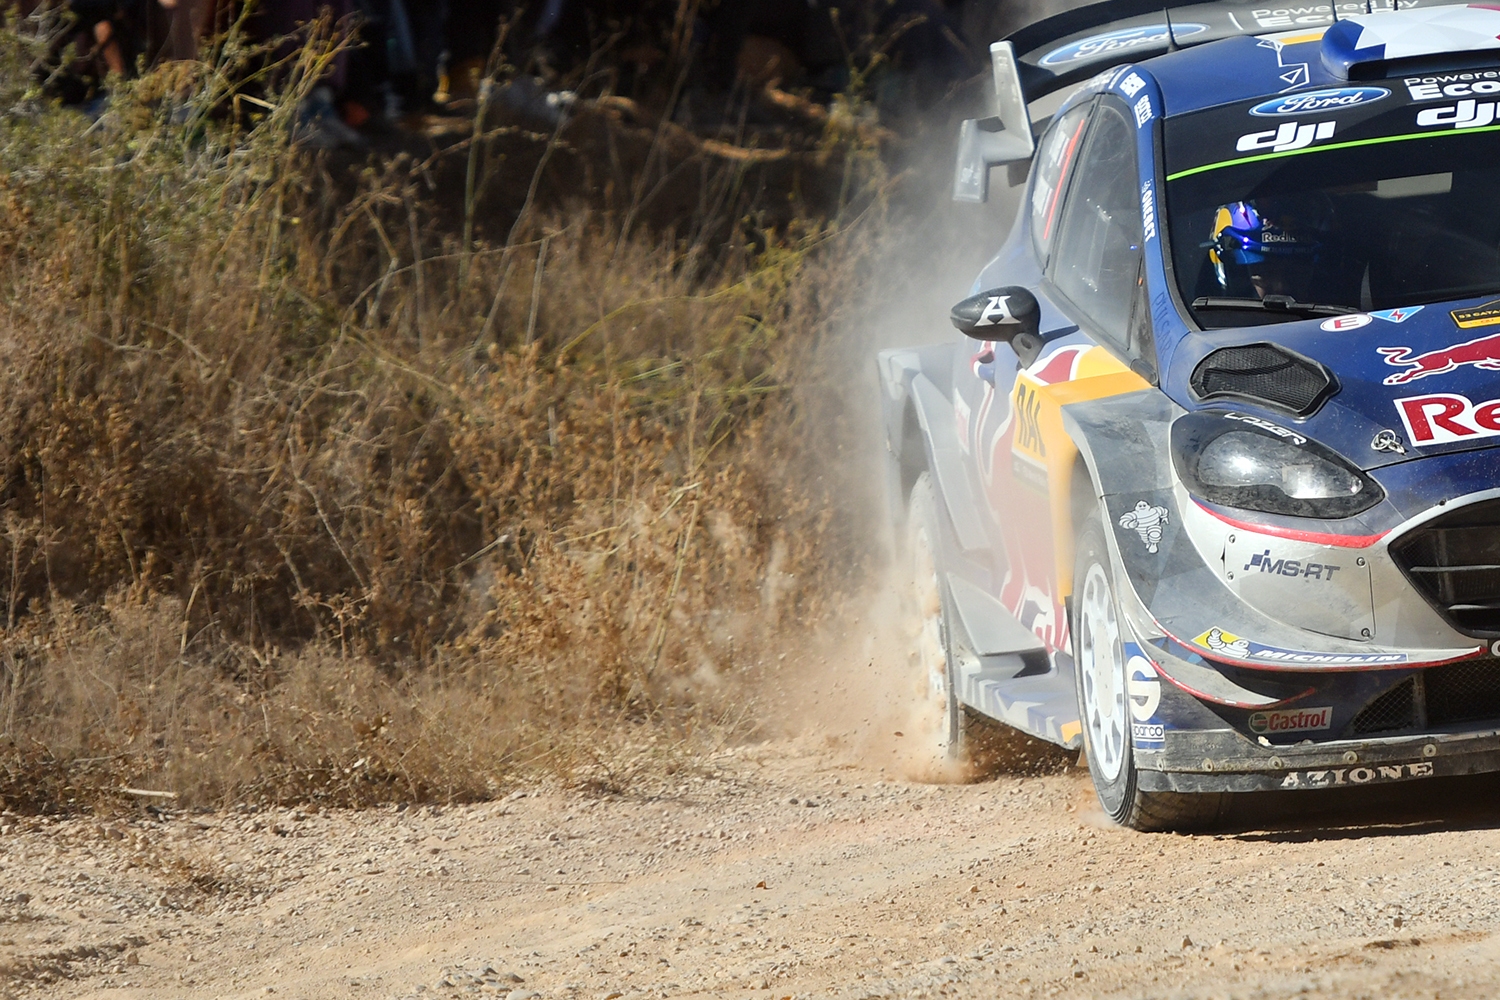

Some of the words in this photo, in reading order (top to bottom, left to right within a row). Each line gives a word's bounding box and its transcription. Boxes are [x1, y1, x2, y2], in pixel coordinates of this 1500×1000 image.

[1252, 0, 1377, 19] Powered
[1276, 90, 1364, 113] Ford
[1254, 649, 1401, 663] MICHELIN
[1268, 710, 1327, 731] Castrol
[1280, 761, 1435, 788] AZIONE
